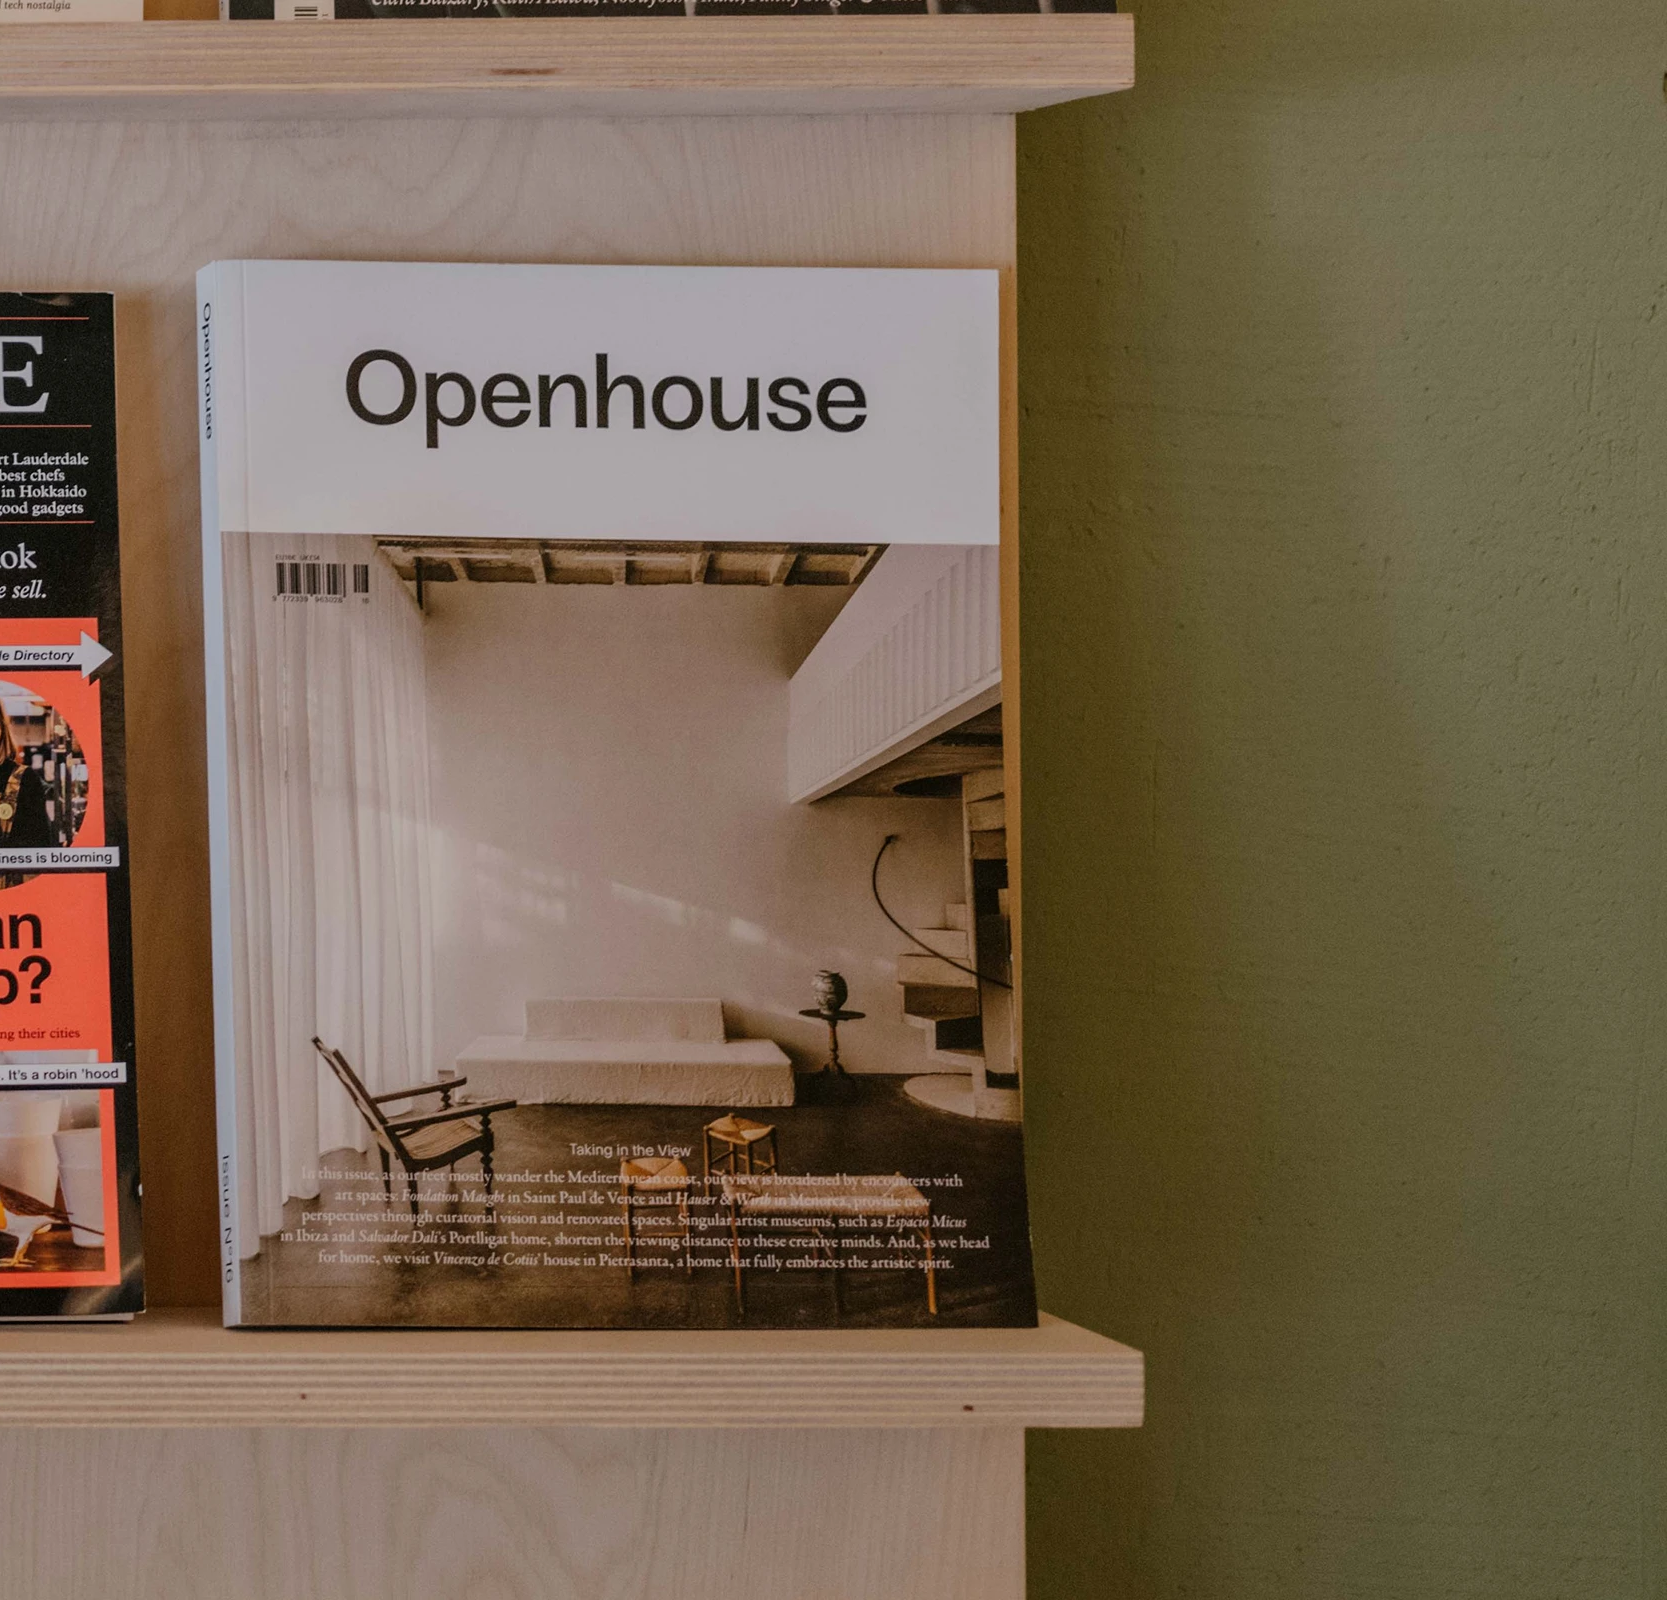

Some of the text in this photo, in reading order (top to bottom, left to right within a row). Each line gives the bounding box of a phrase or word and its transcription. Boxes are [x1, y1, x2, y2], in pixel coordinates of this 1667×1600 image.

[201, 302, 213, 440] Openhouse
[345, 348, 868, 450] Openhouse
[11, 579, 47, 599] sell.
[13, 649, 75, 663] Directory
[35, 852, 48, 864] is
[50, 851, 113, 865] blooming
[569, 1143, 692, 1159] Taking in the View
[221, 1154, 232, 1218] Issue
